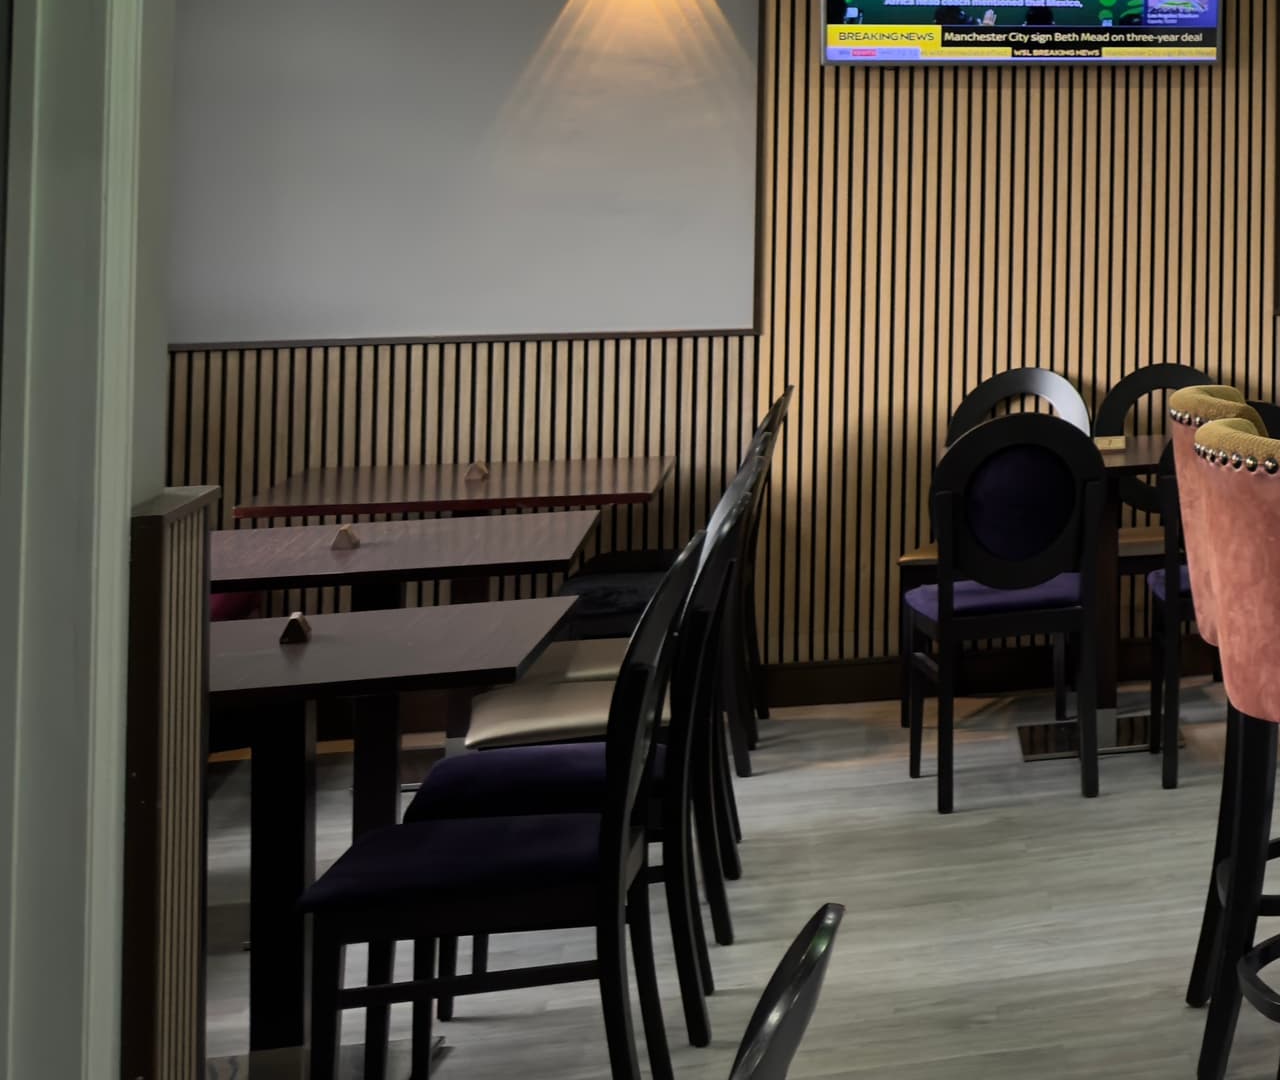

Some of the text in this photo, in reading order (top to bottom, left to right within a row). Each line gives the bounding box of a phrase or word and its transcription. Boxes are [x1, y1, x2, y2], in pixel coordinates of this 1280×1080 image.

[838, 31, 935, 41] BREAKING NEWS
[943, 31, 1203, 44] Manchester City sign Beth Mead on three-year deal
[1033, 49, 1076, 57] BREAKING
[1076, 49, 1100, 57] NEWS
